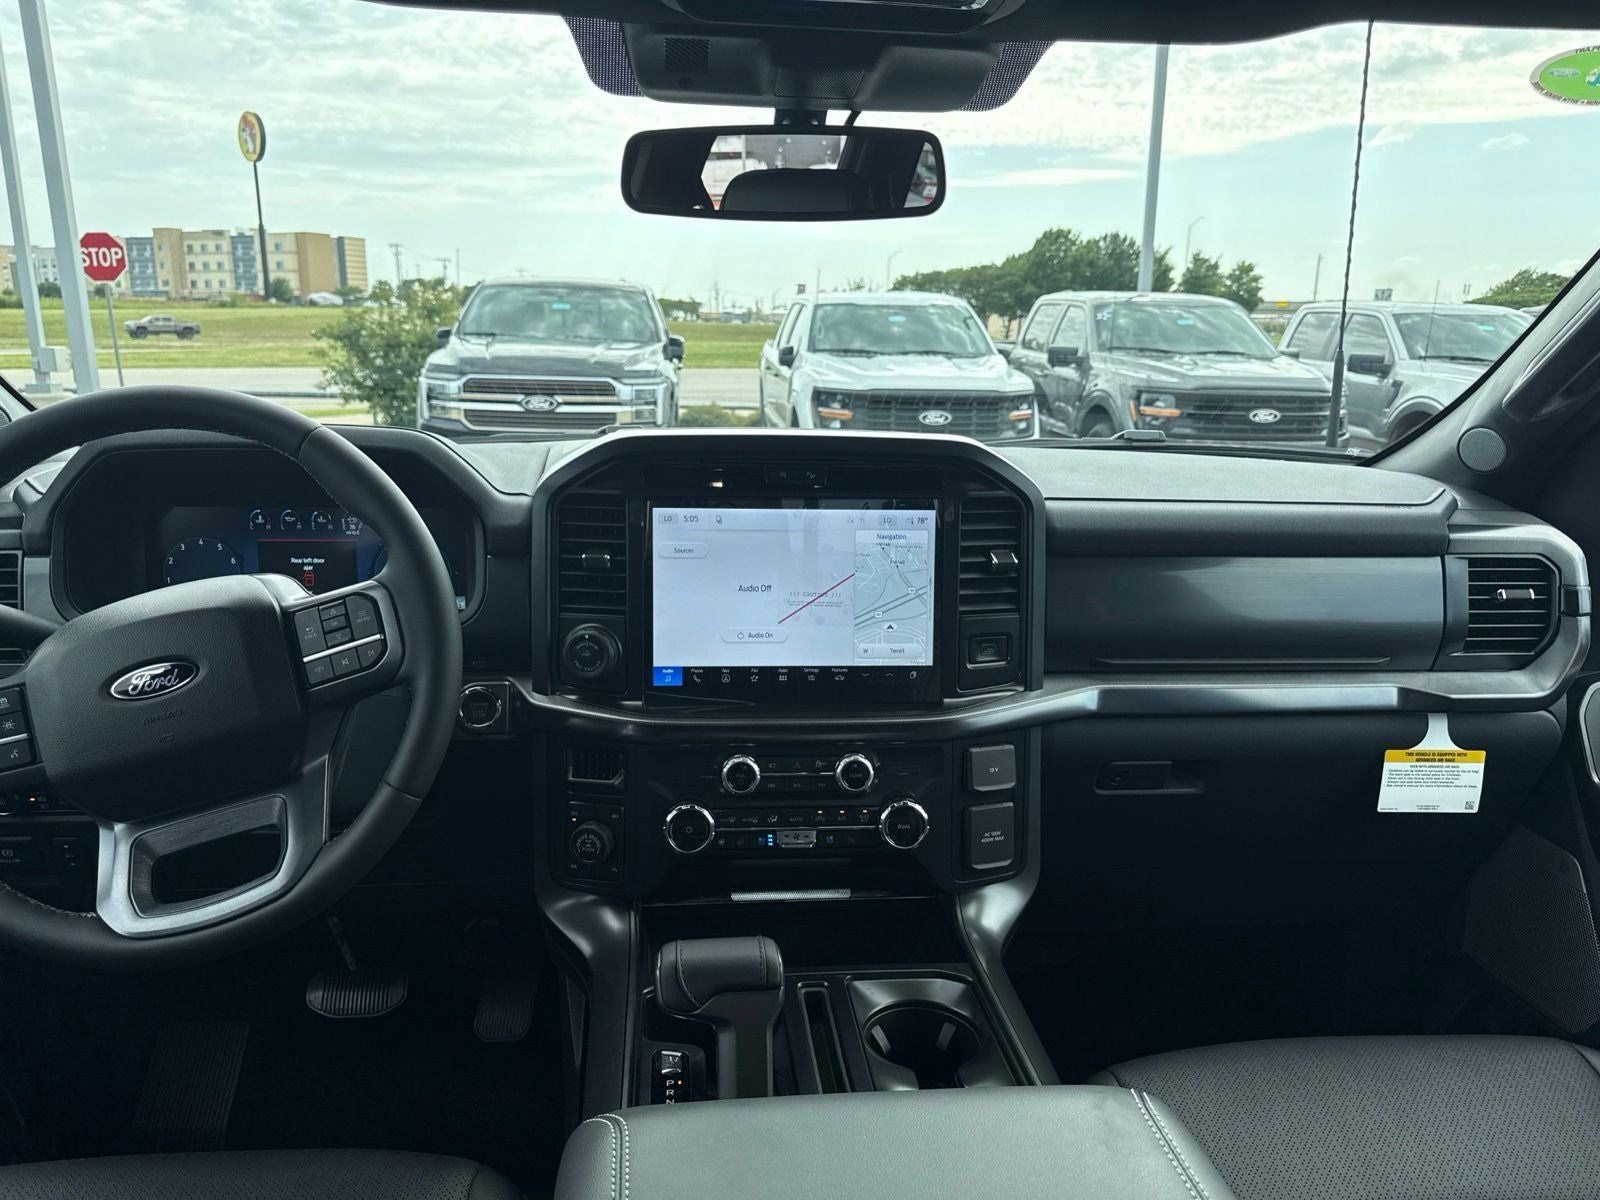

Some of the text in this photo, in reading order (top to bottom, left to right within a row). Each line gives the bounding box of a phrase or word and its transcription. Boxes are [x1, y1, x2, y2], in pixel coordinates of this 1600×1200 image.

[80, 247, 123, 268] STOP
[684, 515, 699, 523] 5:05
[876, 533, 908, 542] Navigation
[180, 543, 186, 551] 3
[198, 538, 204, 547] 4
[738, 584, 773, 593] Audio Off
[748, 632, 774, 640] Audio On
[128, 666, 180, 696] Ford
[666, 1079, 675, 1087] P
